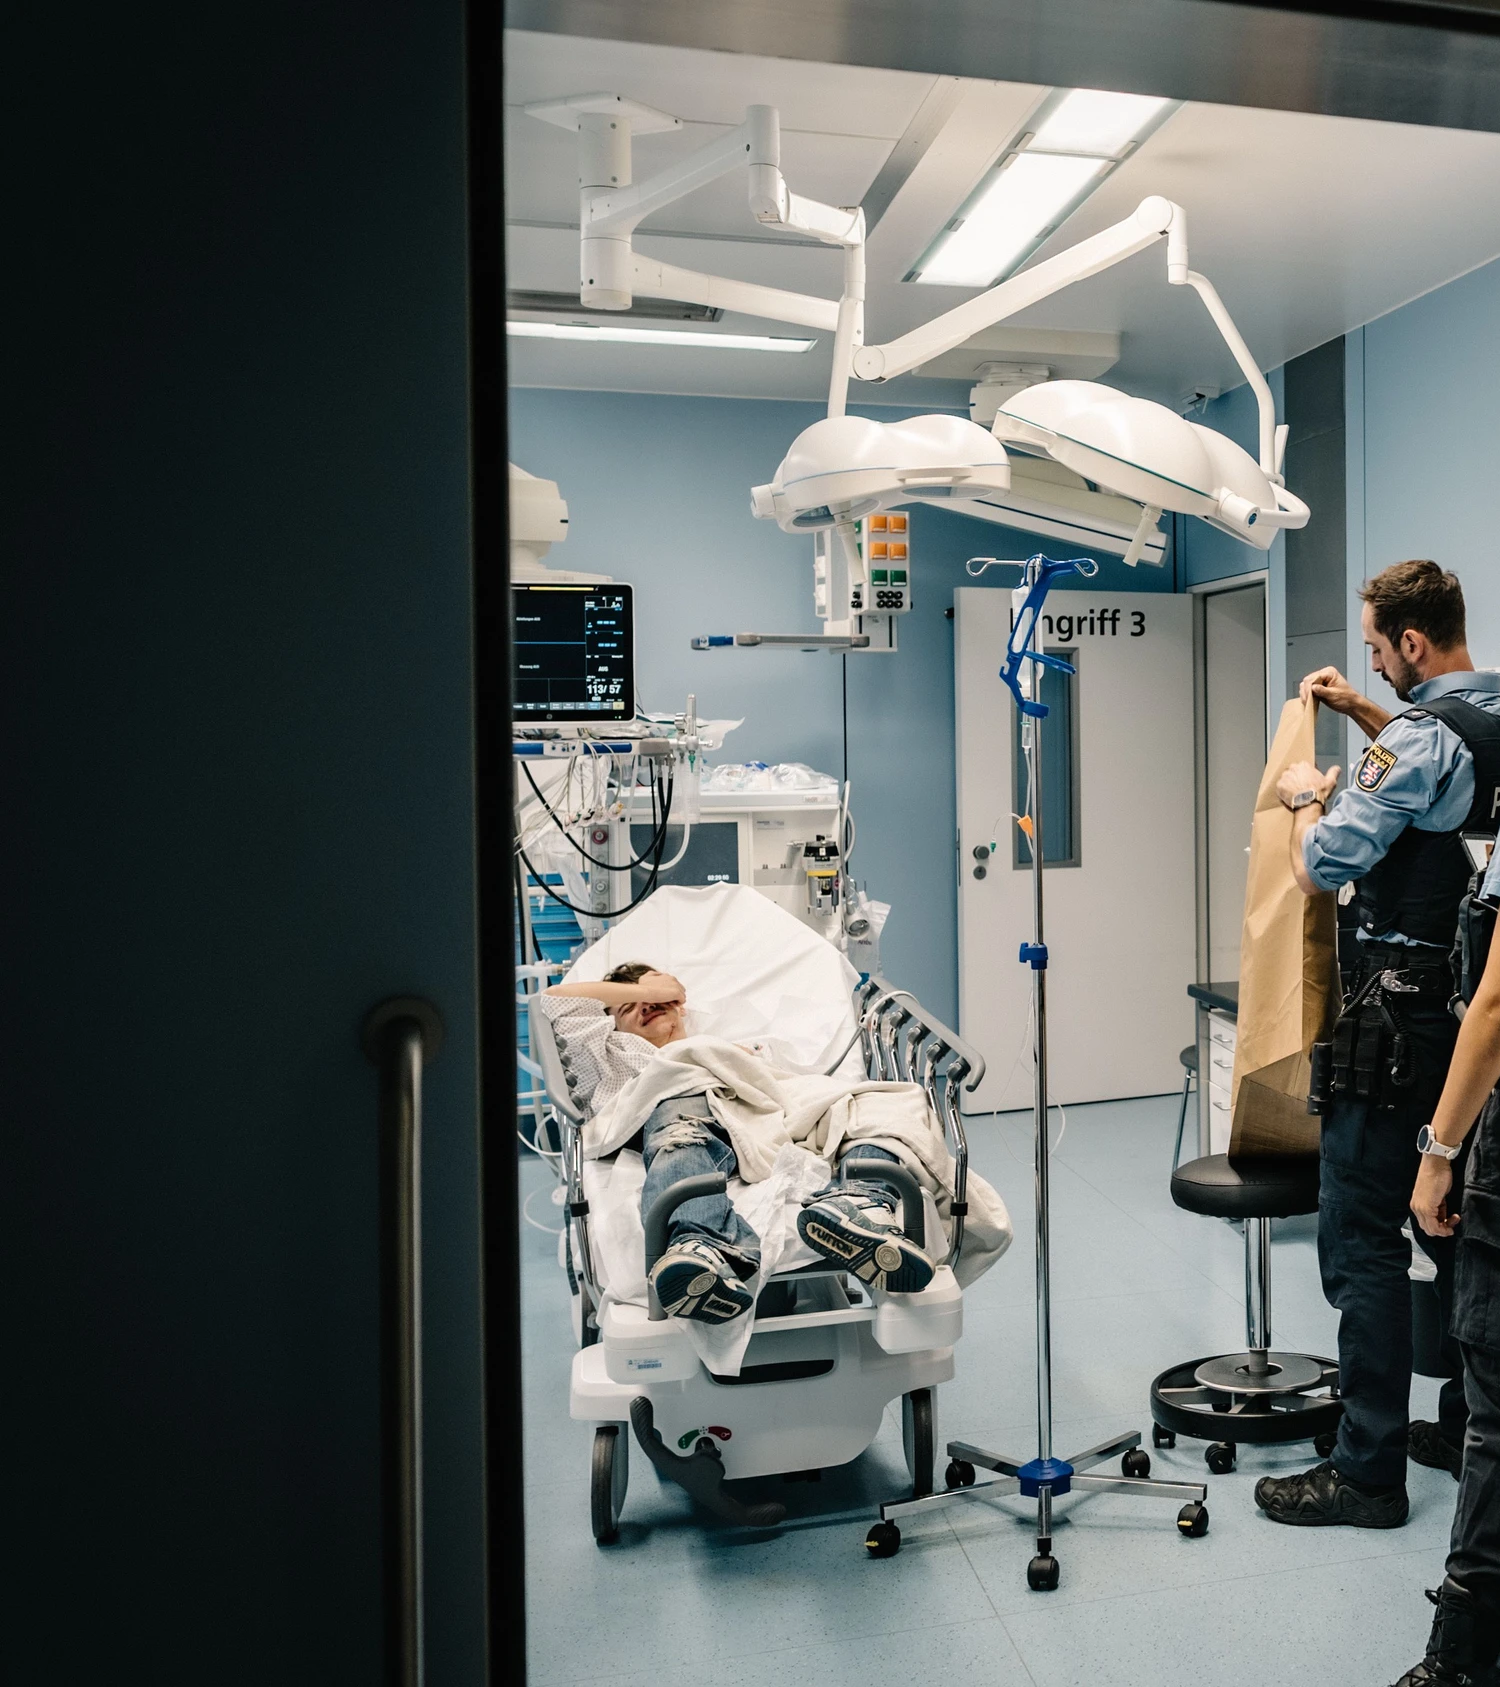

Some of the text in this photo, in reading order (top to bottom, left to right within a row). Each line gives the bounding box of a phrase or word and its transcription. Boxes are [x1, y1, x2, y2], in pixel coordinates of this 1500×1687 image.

[1130, 611, 1146, 637] 3
[609, 685, 621, 694] 57
[811, 1225, 853, 1256] VUITTON
